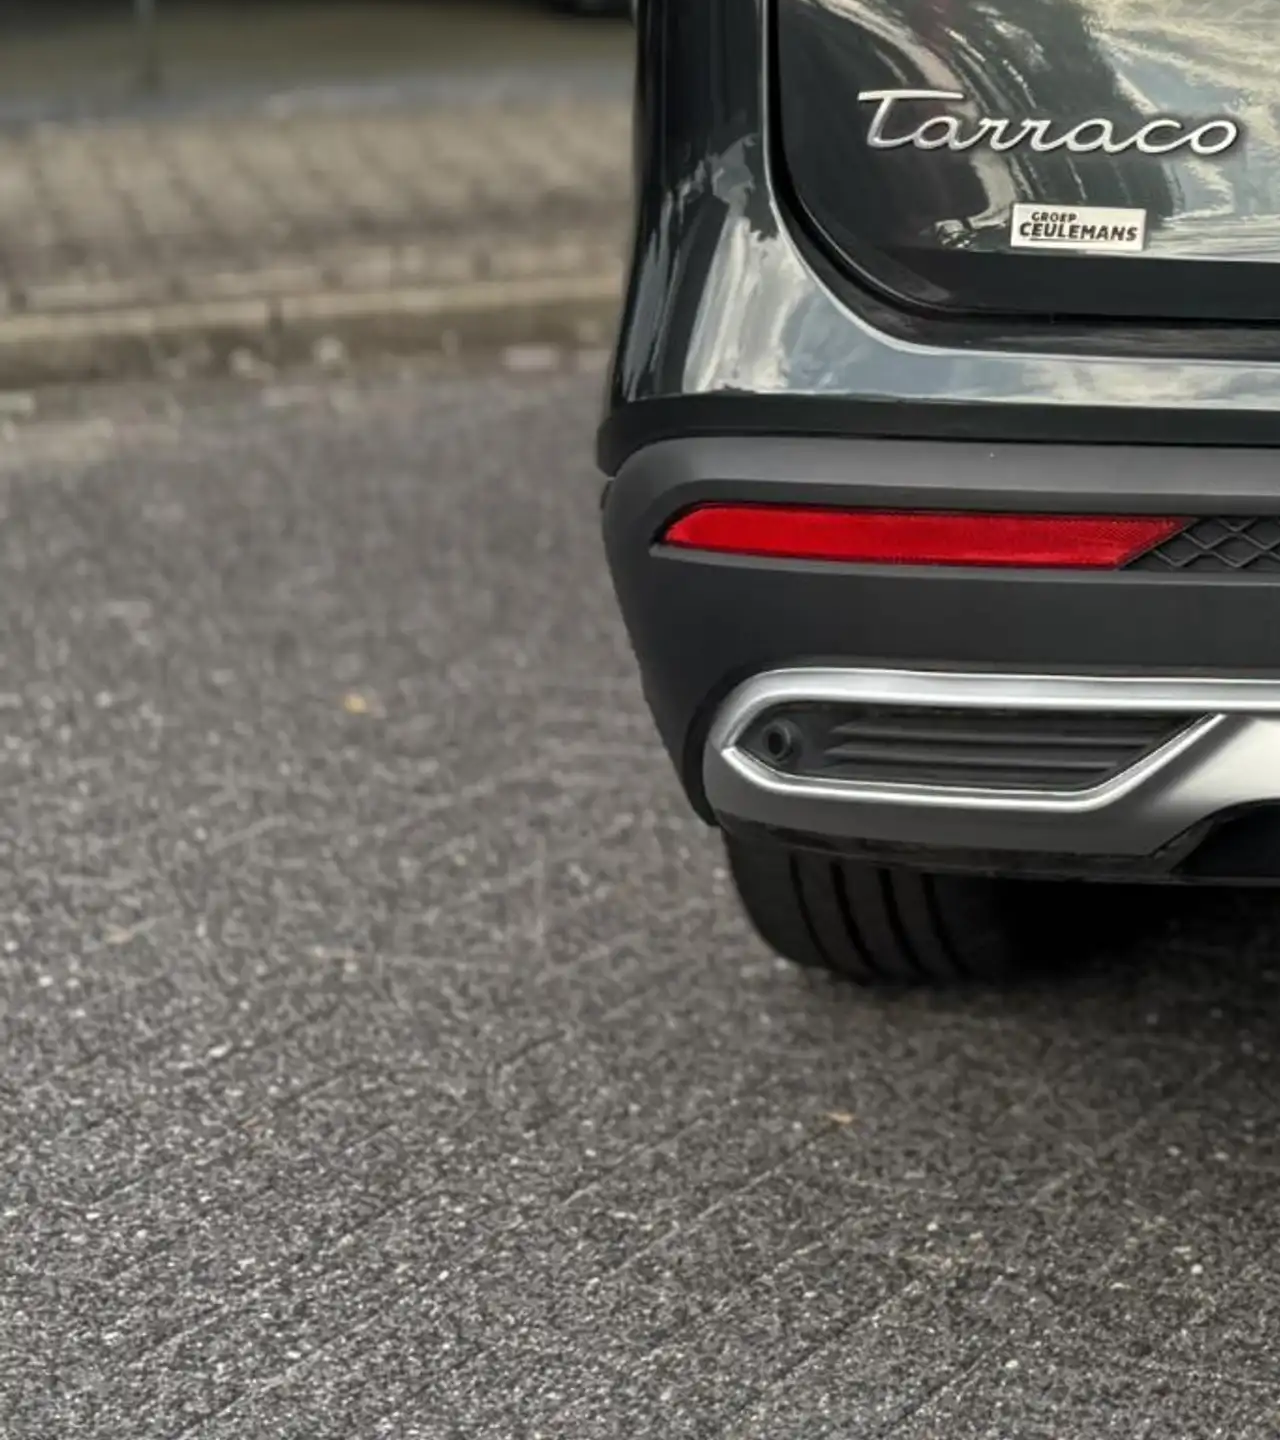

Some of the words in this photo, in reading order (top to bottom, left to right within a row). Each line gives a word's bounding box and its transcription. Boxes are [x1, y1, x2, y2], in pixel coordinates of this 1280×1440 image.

[858, 89, 1239, 154] Tarraco
[1031, 211, 1078, 223] GROEP
[1020, 222, 1139, 241] CEULEMANS
